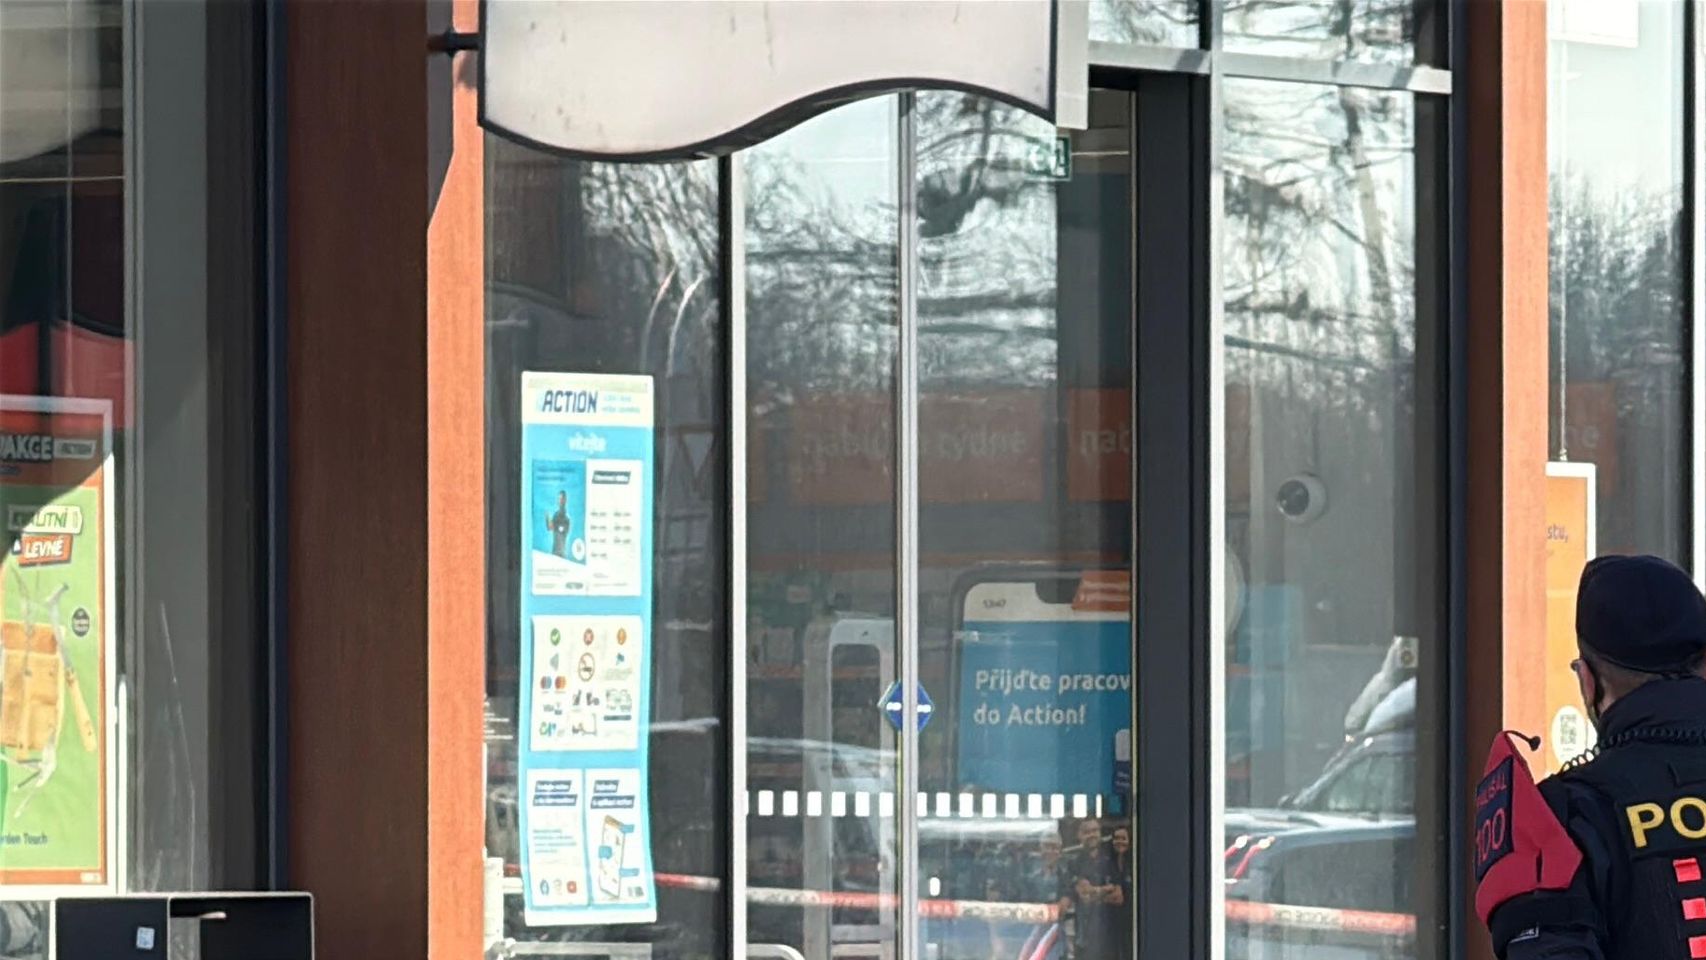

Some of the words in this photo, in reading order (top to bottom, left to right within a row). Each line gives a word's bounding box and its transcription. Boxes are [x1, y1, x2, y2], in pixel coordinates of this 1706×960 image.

[541, 389, 598, 414] ACTION
[25, 536, 65, 559] LEVNÉ
[974, 668, 1051, 696] Přijďte
[1058, 673, 1131, 696] pracov
[973, 703, 1000, 725] do
[1007, 703, 1087, 725] Action!
